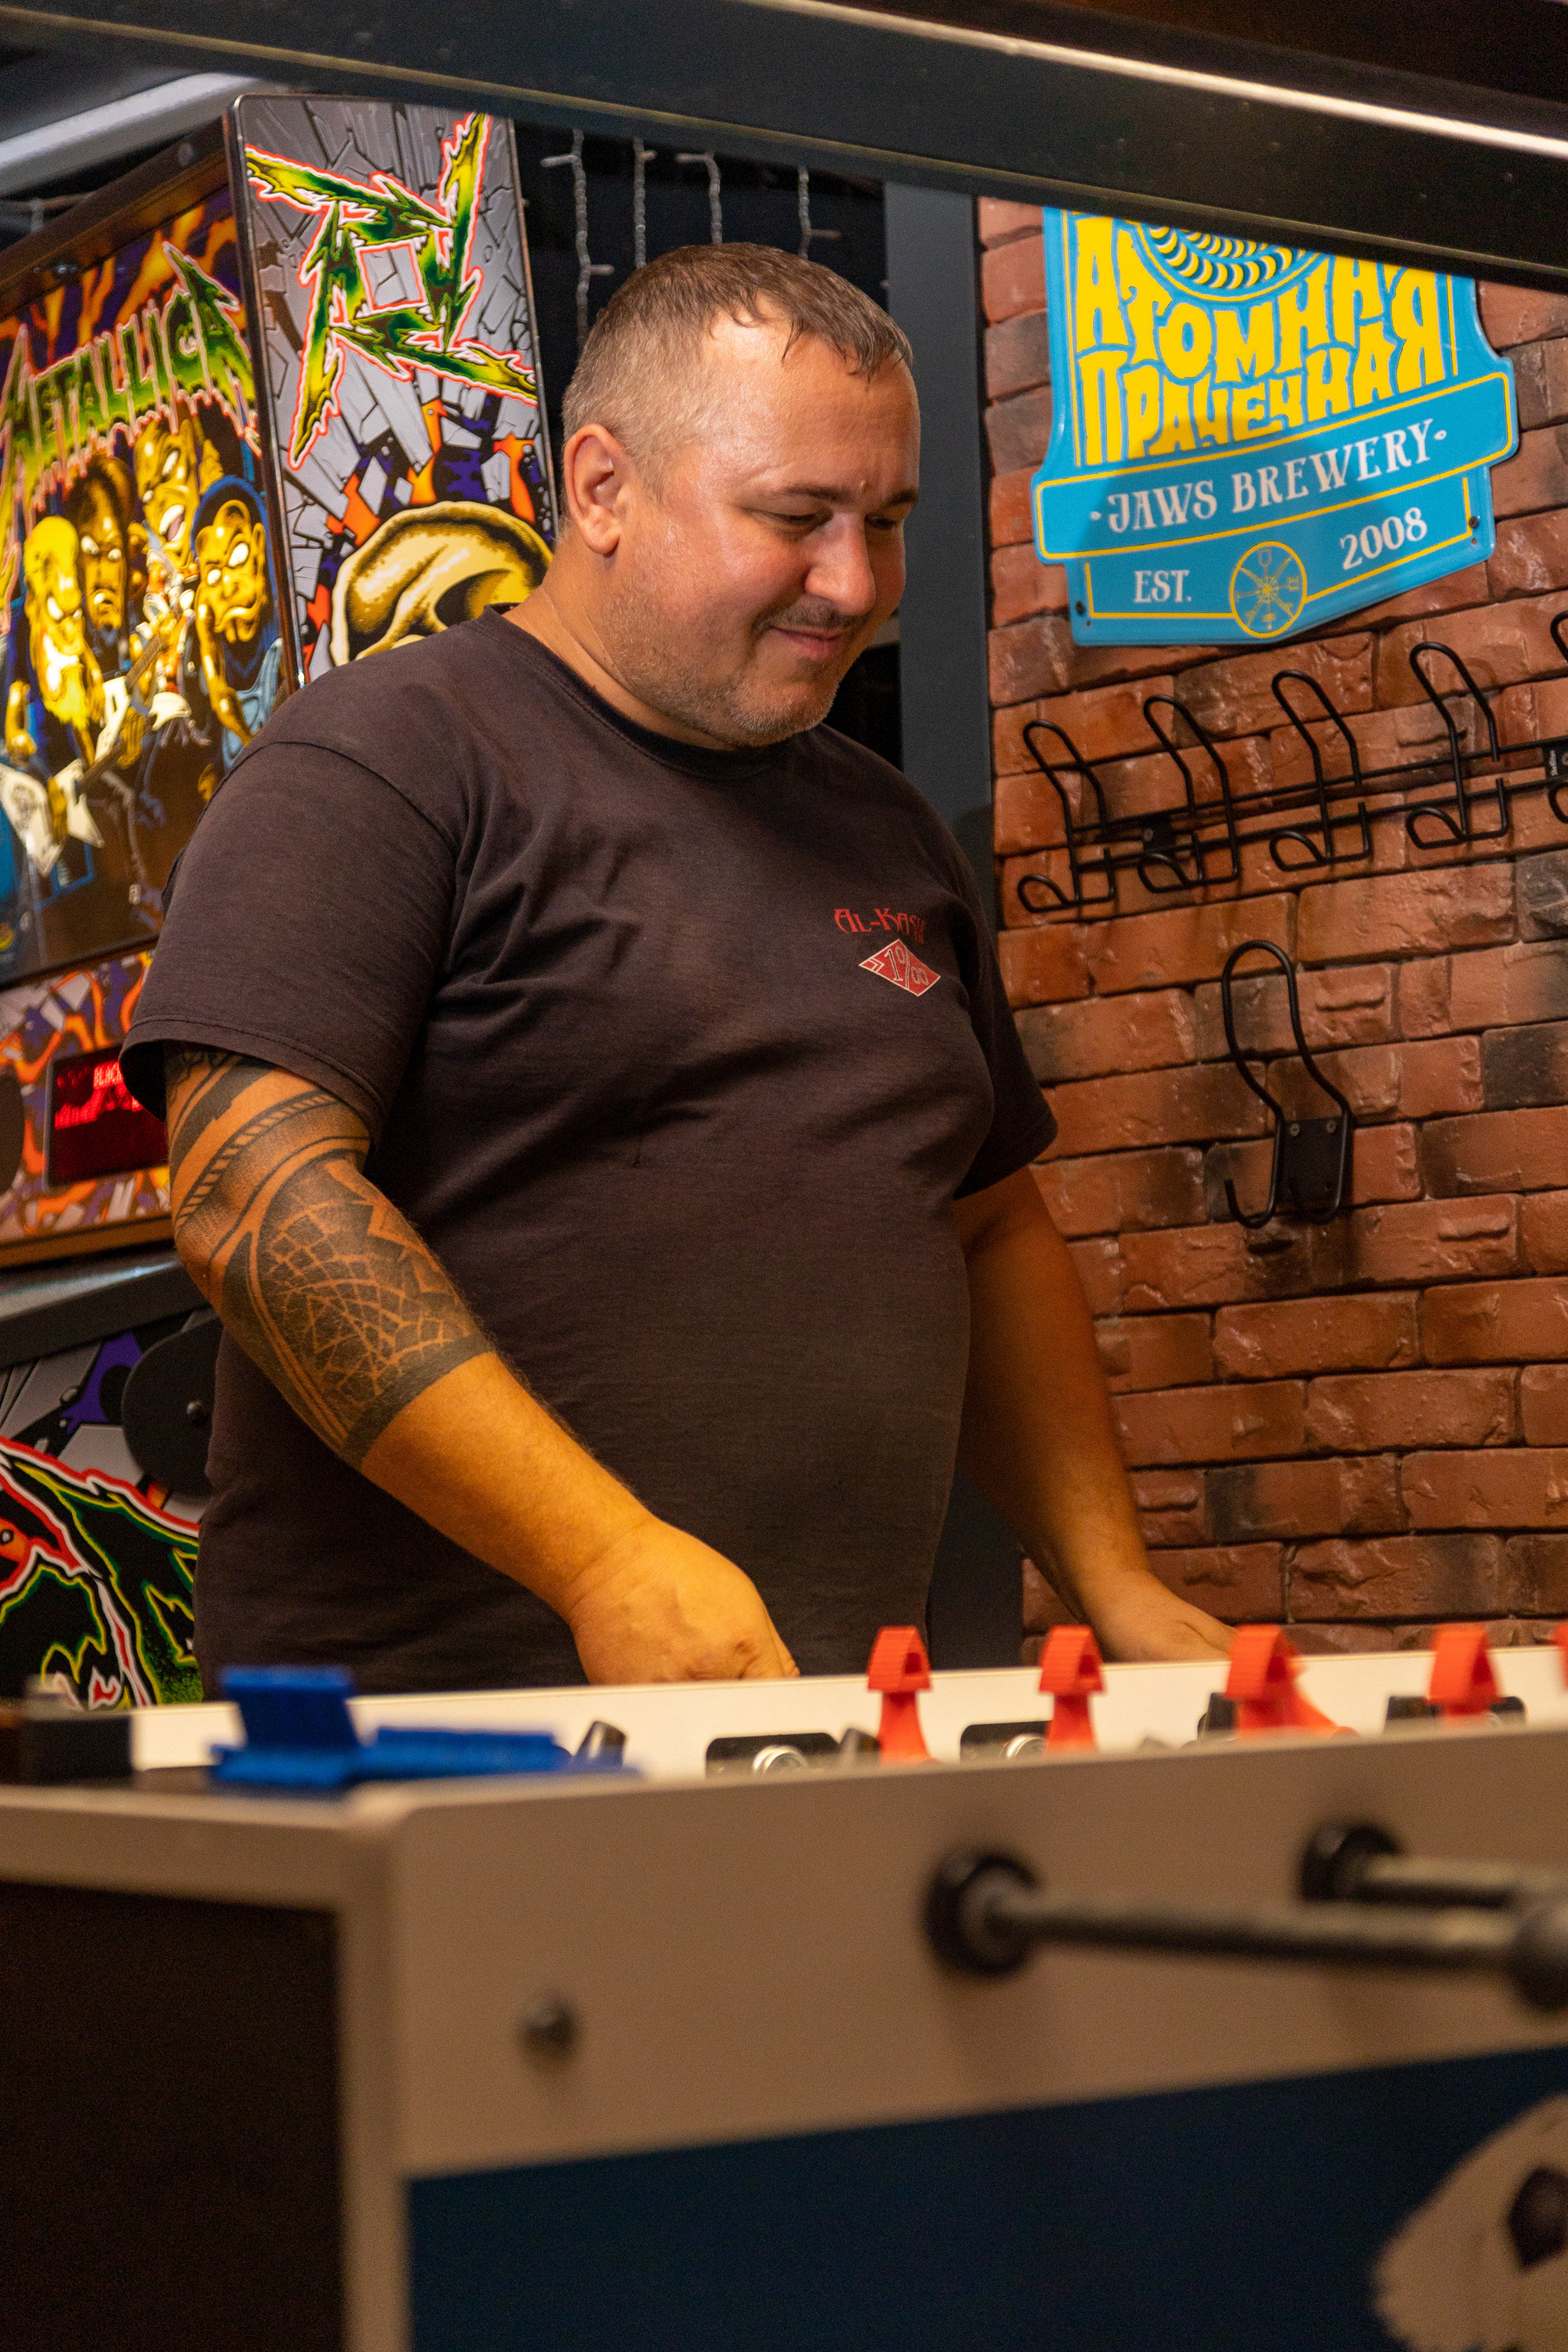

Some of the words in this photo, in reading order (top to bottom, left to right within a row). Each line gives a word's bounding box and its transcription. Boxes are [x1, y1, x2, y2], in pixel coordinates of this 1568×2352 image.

[1107, 480, 1217, 533] JAWS
[1232, 419, 1434, 513] BREWERY
[1134, 569, 1192, 604] EST.
[1340, 506, 1428, 571] 2008
